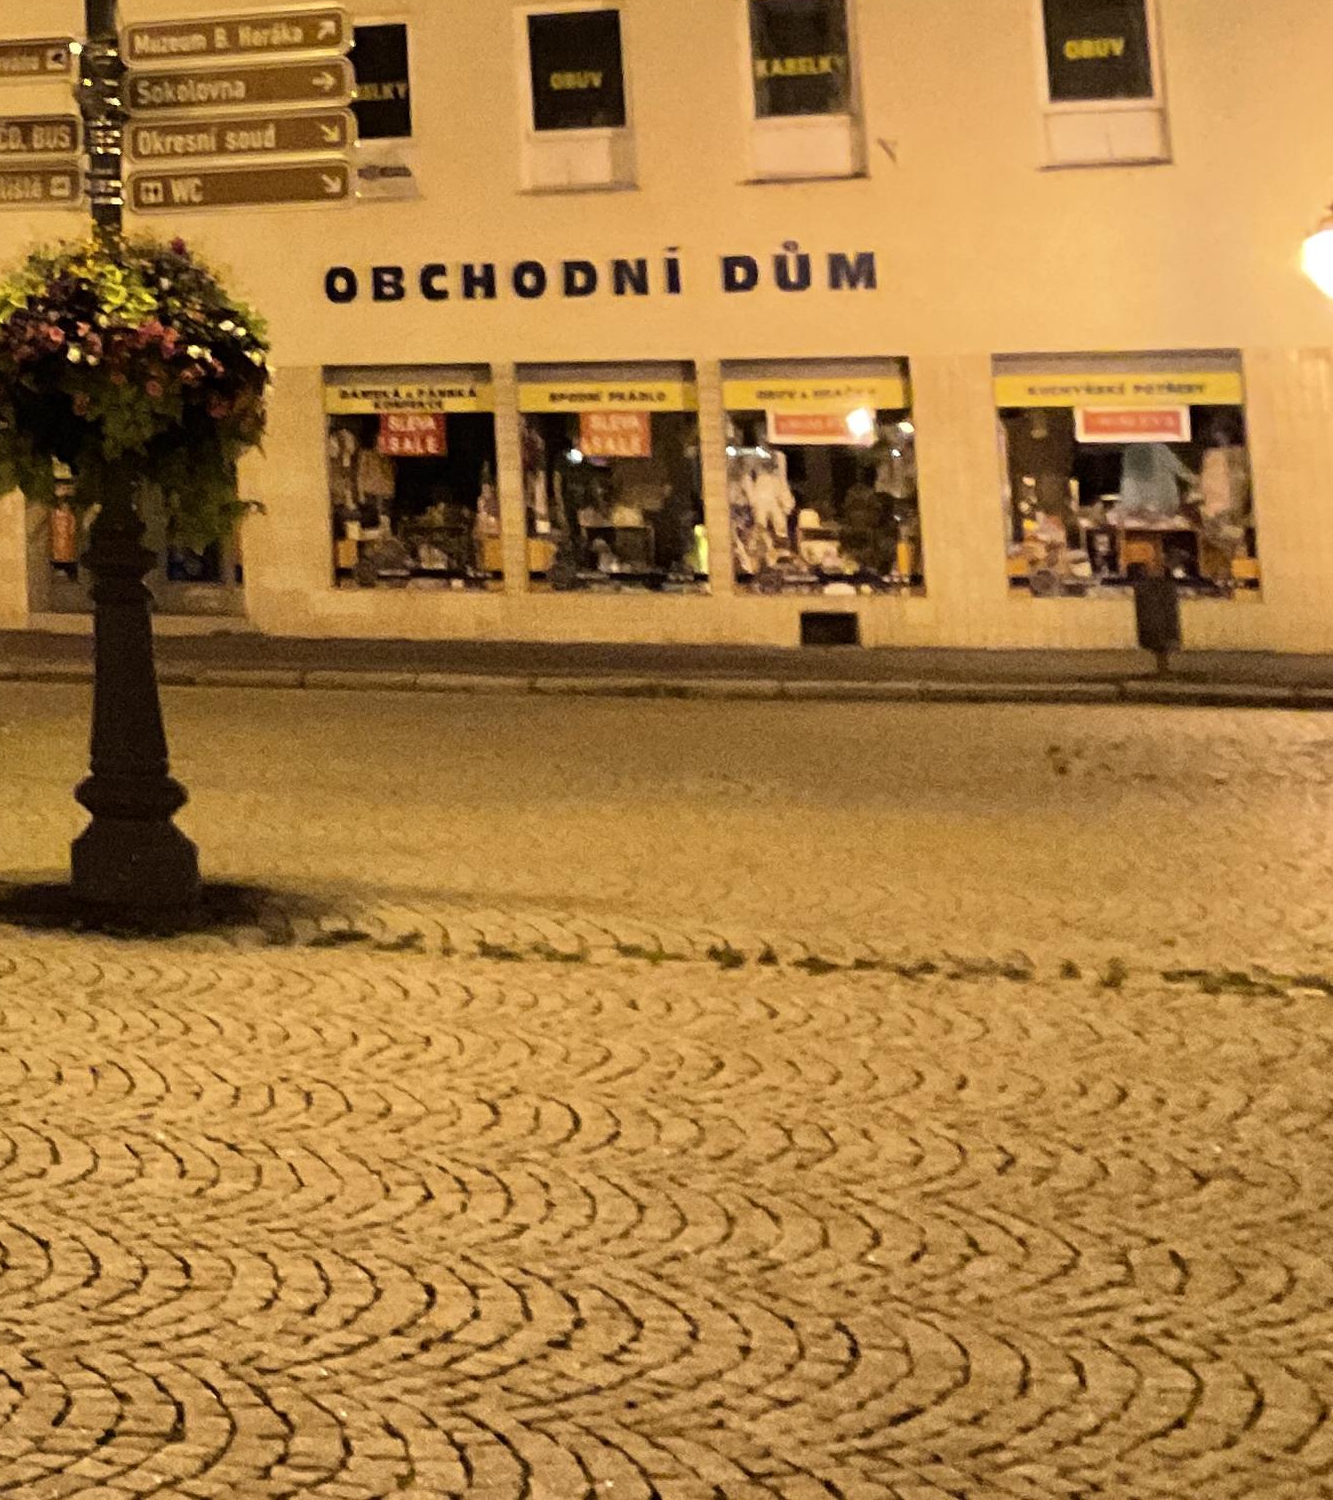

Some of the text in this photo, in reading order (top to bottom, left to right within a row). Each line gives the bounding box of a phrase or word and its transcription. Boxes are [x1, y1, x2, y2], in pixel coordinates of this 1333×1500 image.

[1062, 36, 1124, 61] OBUV
[136, 79, 247, 105] Sokolovna
[549, 71, 603, 90] OBUV
[32, 123, 71, 151] BUS
[137, 122, 277, 155] Okresní soud
[170, 177, 204, 204] WC
[324, 240, 878, 304] OBCHODNÍ DŮM
